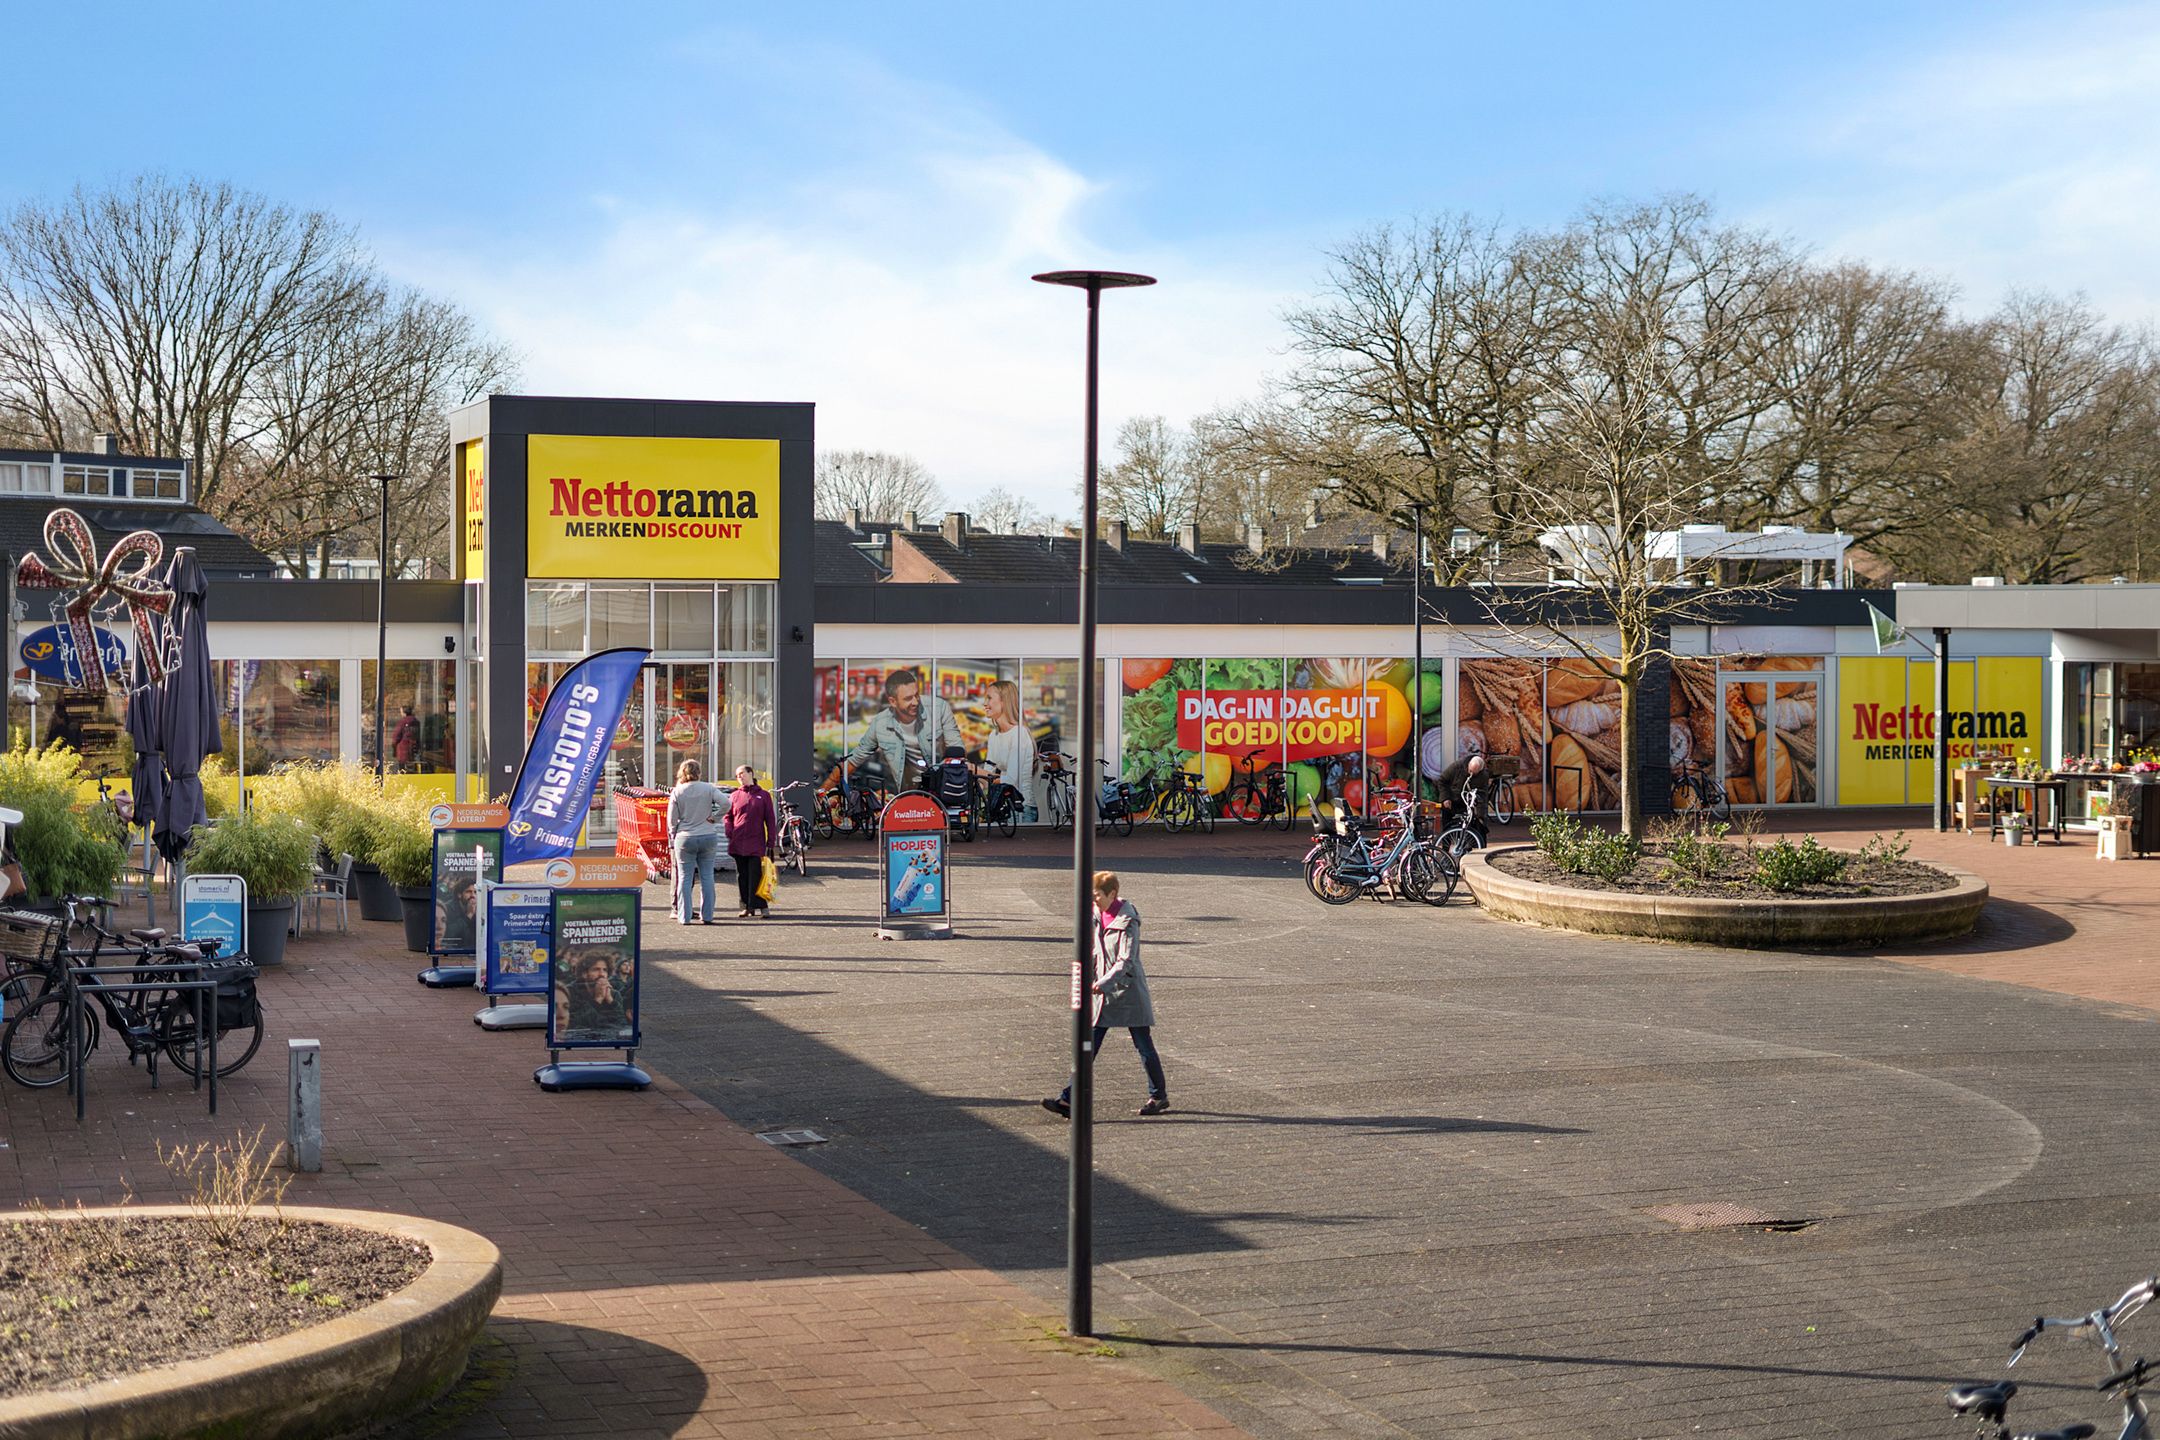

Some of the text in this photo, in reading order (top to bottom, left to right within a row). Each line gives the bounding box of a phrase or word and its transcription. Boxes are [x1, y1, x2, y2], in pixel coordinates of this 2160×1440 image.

[549, 478, 758, 518] Nettorama
[565, 522, 742, 539] MERKENDISCOUNT
[1184, 697, 1273, 719] DAG-IN
[1205, 720, 1362, 745] GOEDKOOP!
[532, 683, 599, 818] PASFOTO'S
[564, 726, 607, 824] HIER VERKRIJGBAAR
[457, 815, 486, 823] LOTERIJ
[893, 810, 931, 819] kwalitaria
[534, 827, 575, 848] Primera
[891, 840, 937, 851] HOPJES!
[580, 864, 639, 873] NEDERLANDSE
[580, 873, 617, 881] LOTERIJ
[523, 894, 551, 904] Primera
[509, 912, 527, 921] Spaar
[562, 925, 628, 938] SPANNENDER
